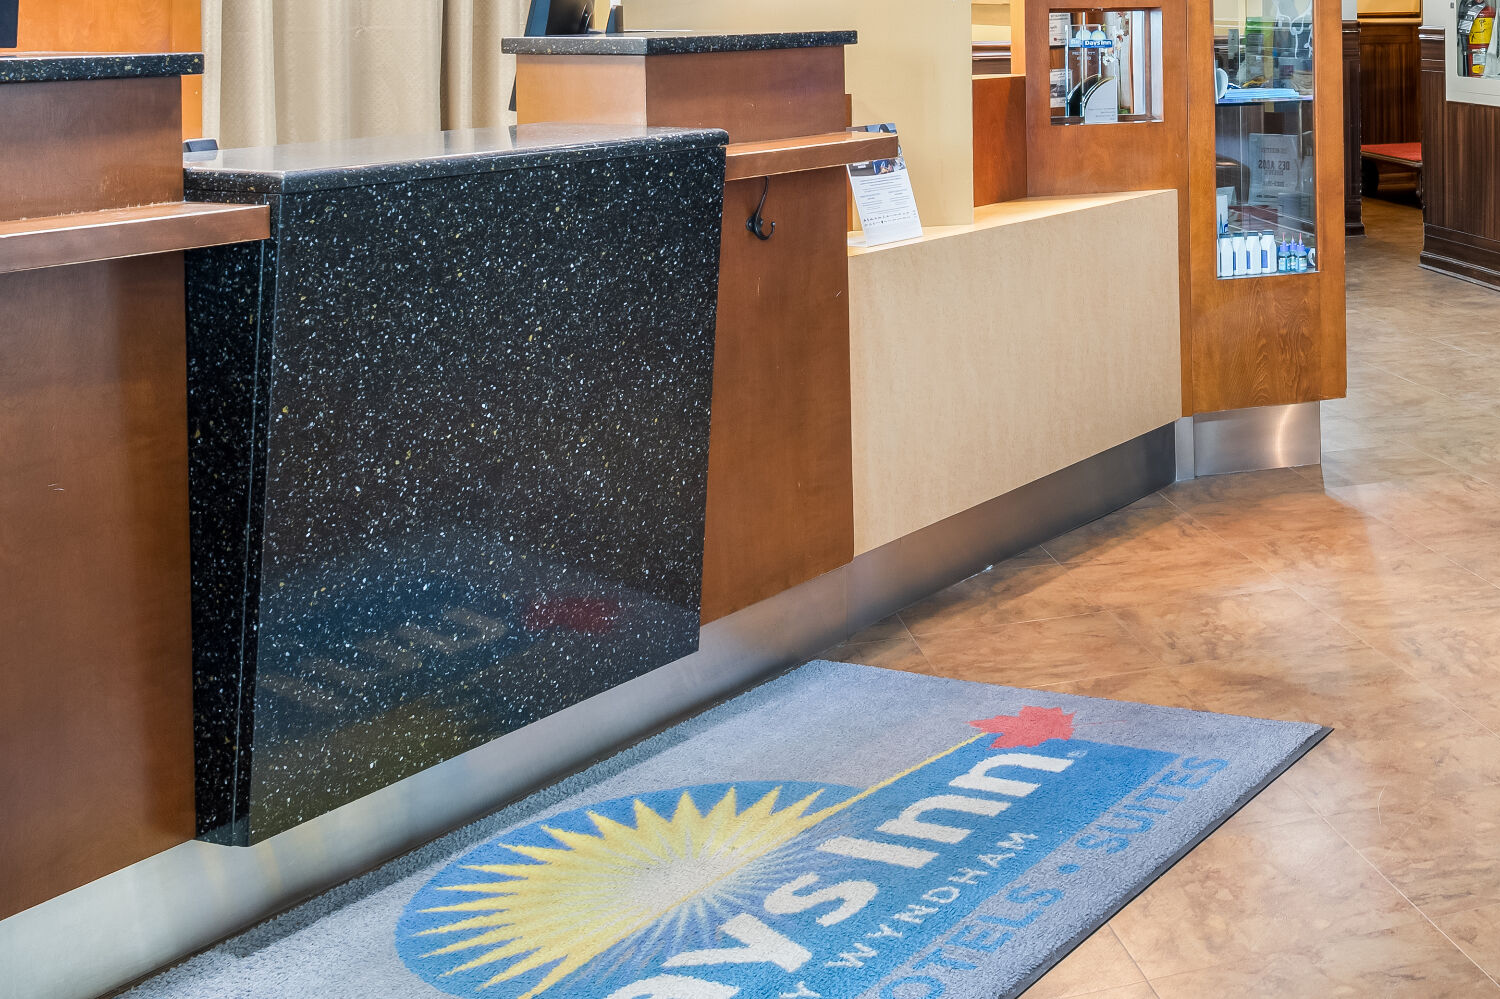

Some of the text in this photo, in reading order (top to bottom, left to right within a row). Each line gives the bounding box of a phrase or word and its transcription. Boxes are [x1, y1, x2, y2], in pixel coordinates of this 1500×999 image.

[604, 752, 1075, 999] ys Inn
[825, 831, 1039, 969] WYNDHAM
[878, 756, 1229, 999] OTELS SUITES
